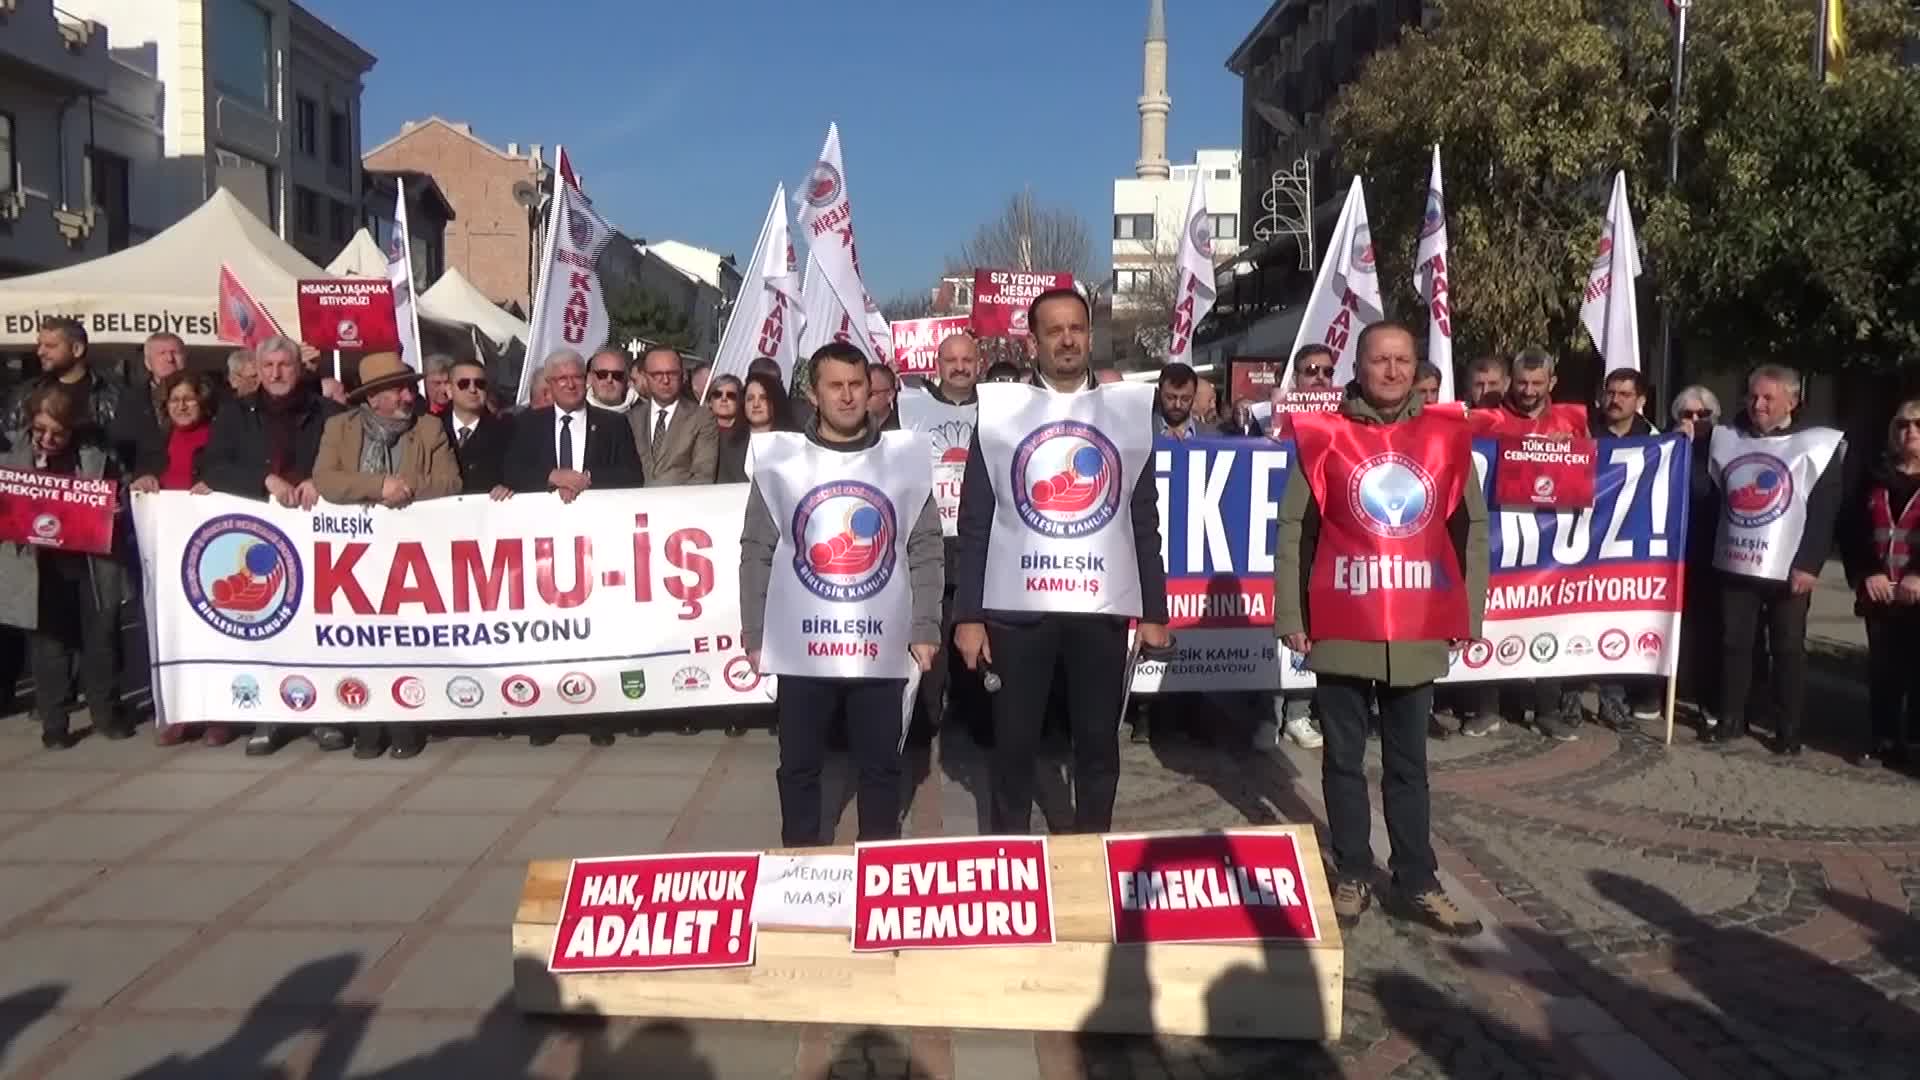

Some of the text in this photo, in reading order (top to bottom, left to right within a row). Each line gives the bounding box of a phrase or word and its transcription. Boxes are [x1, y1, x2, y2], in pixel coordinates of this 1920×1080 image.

[93, 310, 218, 335] BELEDİYESİ
[0, 468, 70, 490] ERMAYEYE
[0, 483, 107, 508] MEKÇİYE BÜTÇE
[312, 513, 374, 538] BİRLEŞİK
[313, 513, 716, 620] KAMU-İŞ
[1021, 550, 1105, 573] BİRLEŞİK
[1334, 554, 1432, 595] Eğitim
[1026, 575, 1099, 596] KAMU-İŞ
[1556, 574, 1668, 606] İSTİYORUZ
[316, 617, 592, 648] KONFEDERASYONU
[802, 614, 884, 638] BİRLEŞİK
[807, 640, 879, 661] KAMU-İŞ
[864, 847, 1040, 897] DEVLETİN
[1117, 855, 1302, 910] EMEKLİLER
[580, 870, 748, 912] HAK, HUKUK
[564, 910, 719, 958] ADALET
[865, 901, 1038, 942] MEMURU
